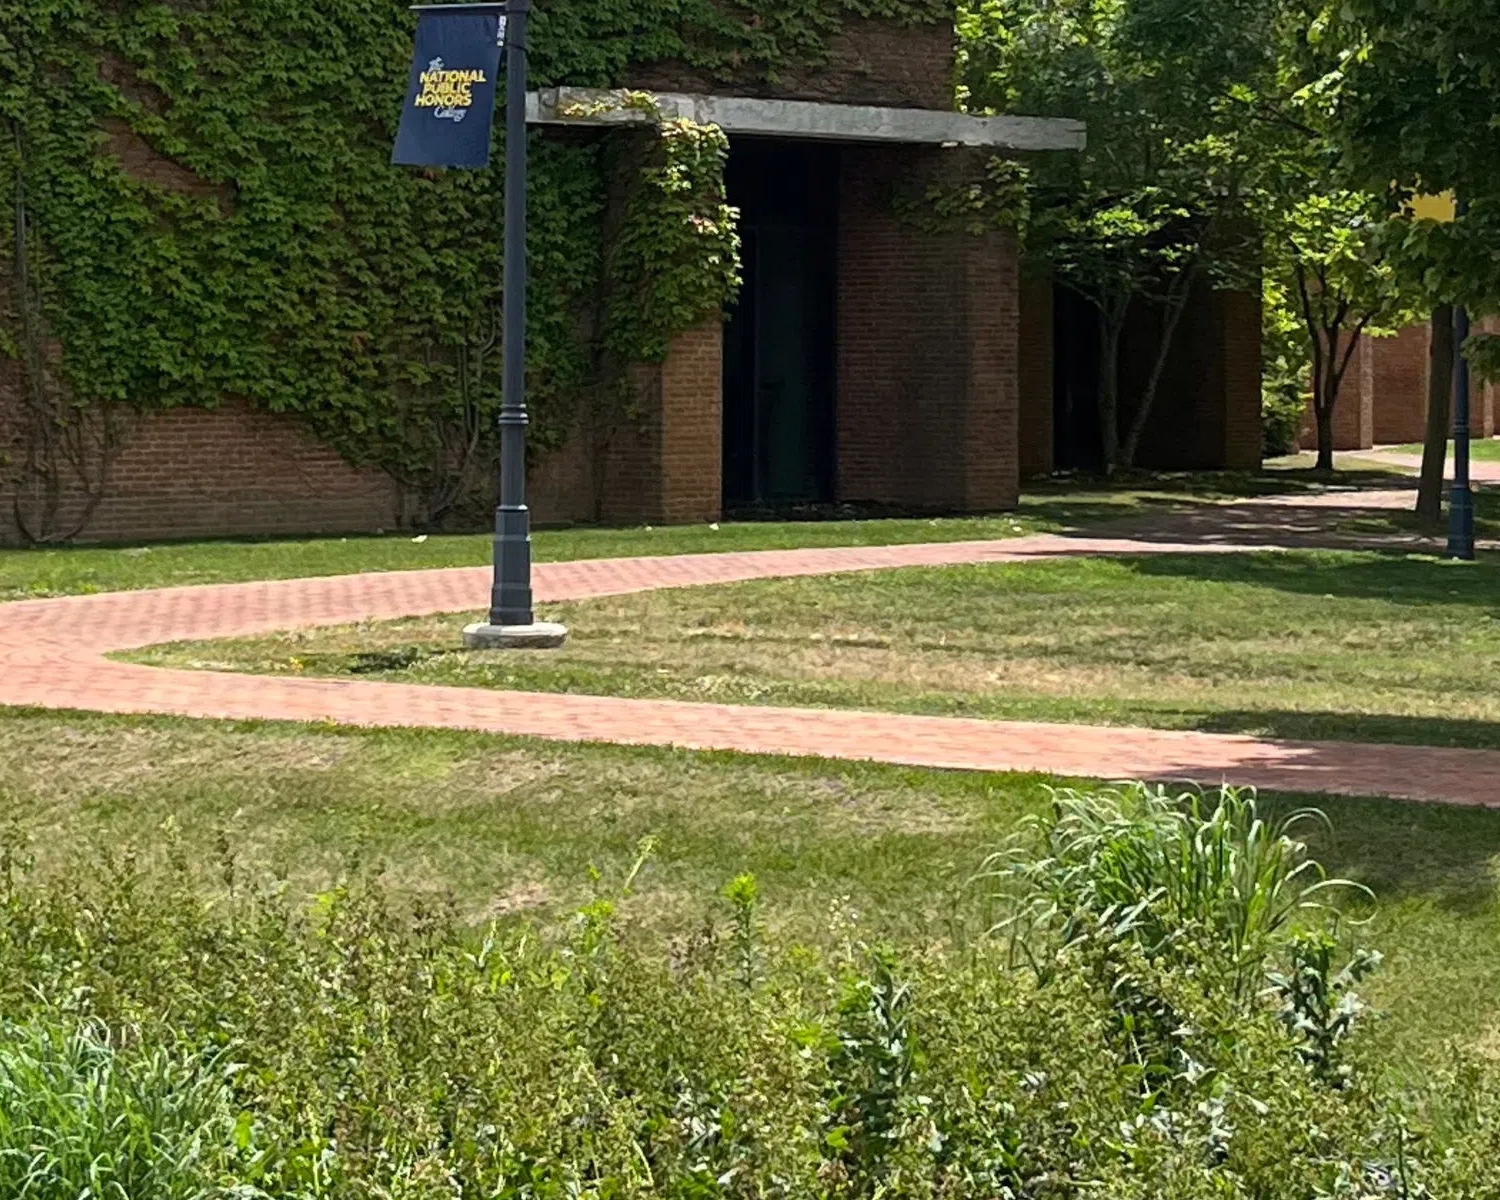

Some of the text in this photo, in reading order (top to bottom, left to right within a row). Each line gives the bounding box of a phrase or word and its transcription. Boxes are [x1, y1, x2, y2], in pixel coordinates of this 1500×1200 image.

[419, 70, 486, 84] NATIONAL
[423, 82, 471, 95] PUBLIC
[414, 93, 472, 107] HONORS
